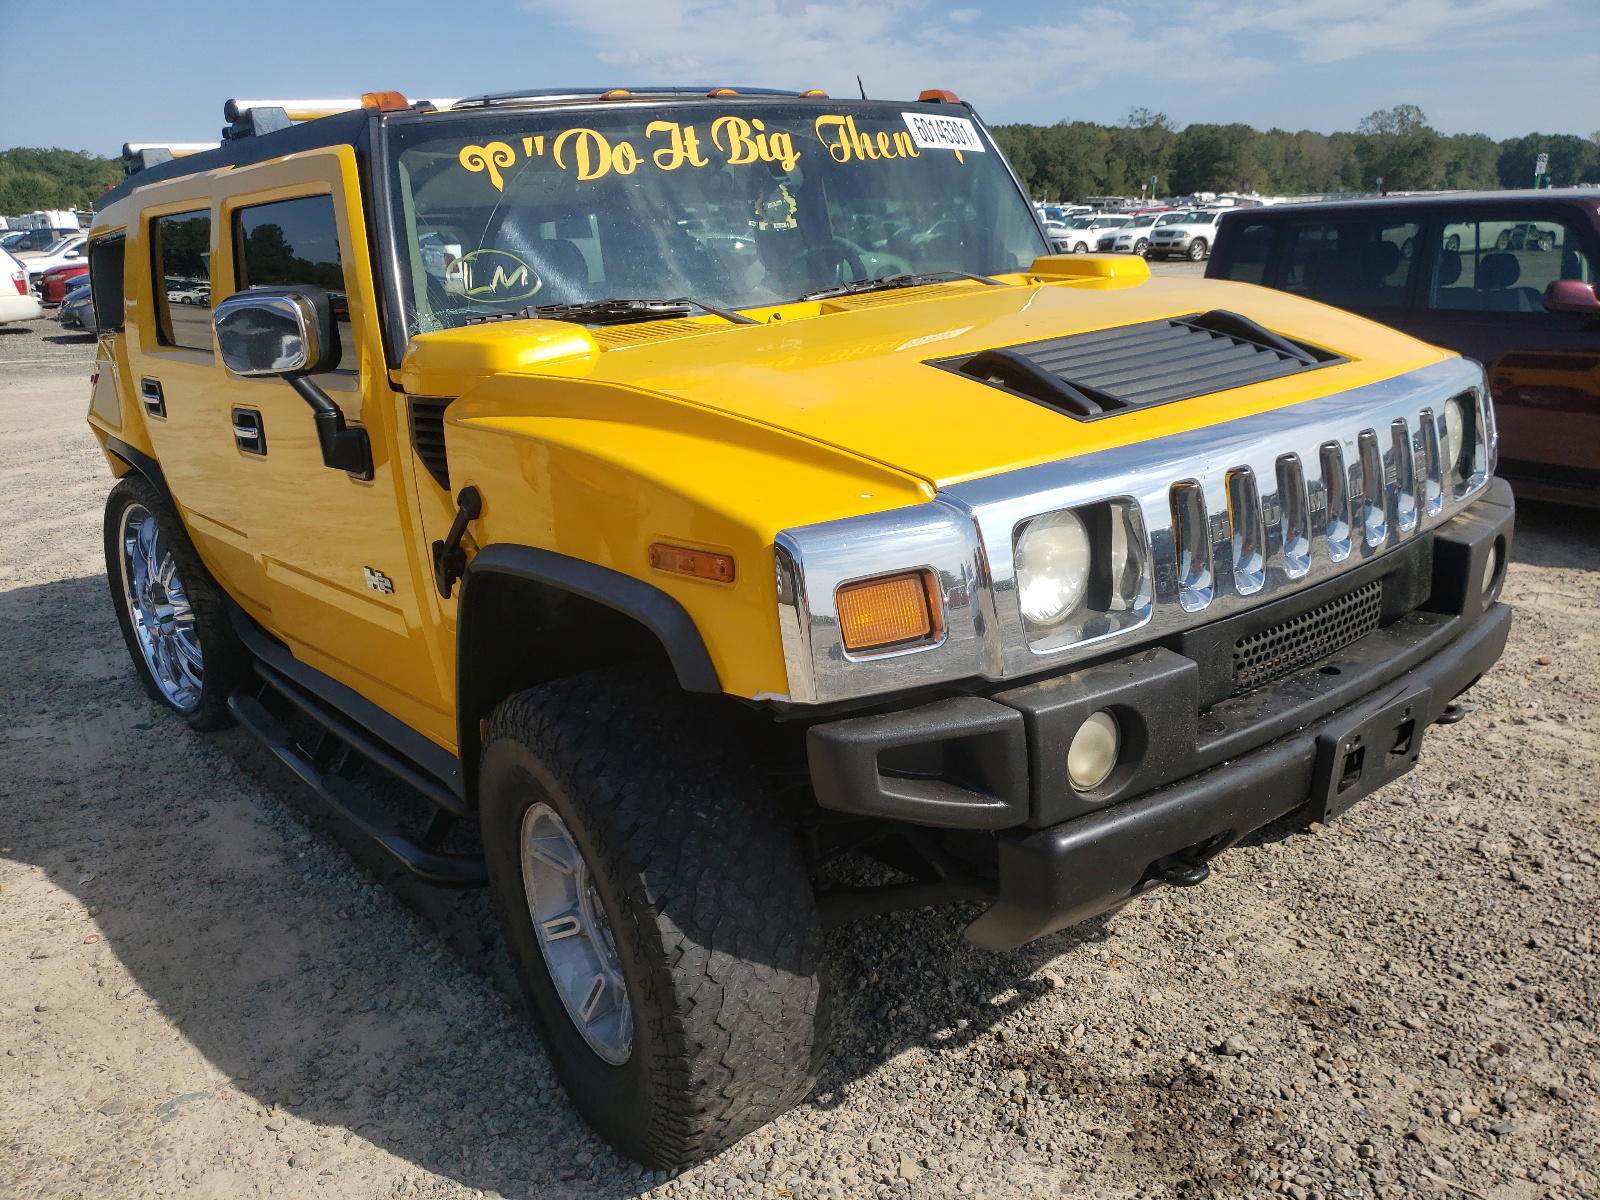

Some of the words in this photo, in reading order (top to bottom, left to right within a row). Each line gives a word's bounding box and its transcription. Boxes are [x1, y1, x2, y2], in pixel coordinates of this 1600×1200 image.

[645, 120, 709, 171] It
[709, 116, 801, 172] Big
[815, 114, 920, 163] Then
[912, 117, 974, 146] 60145301
